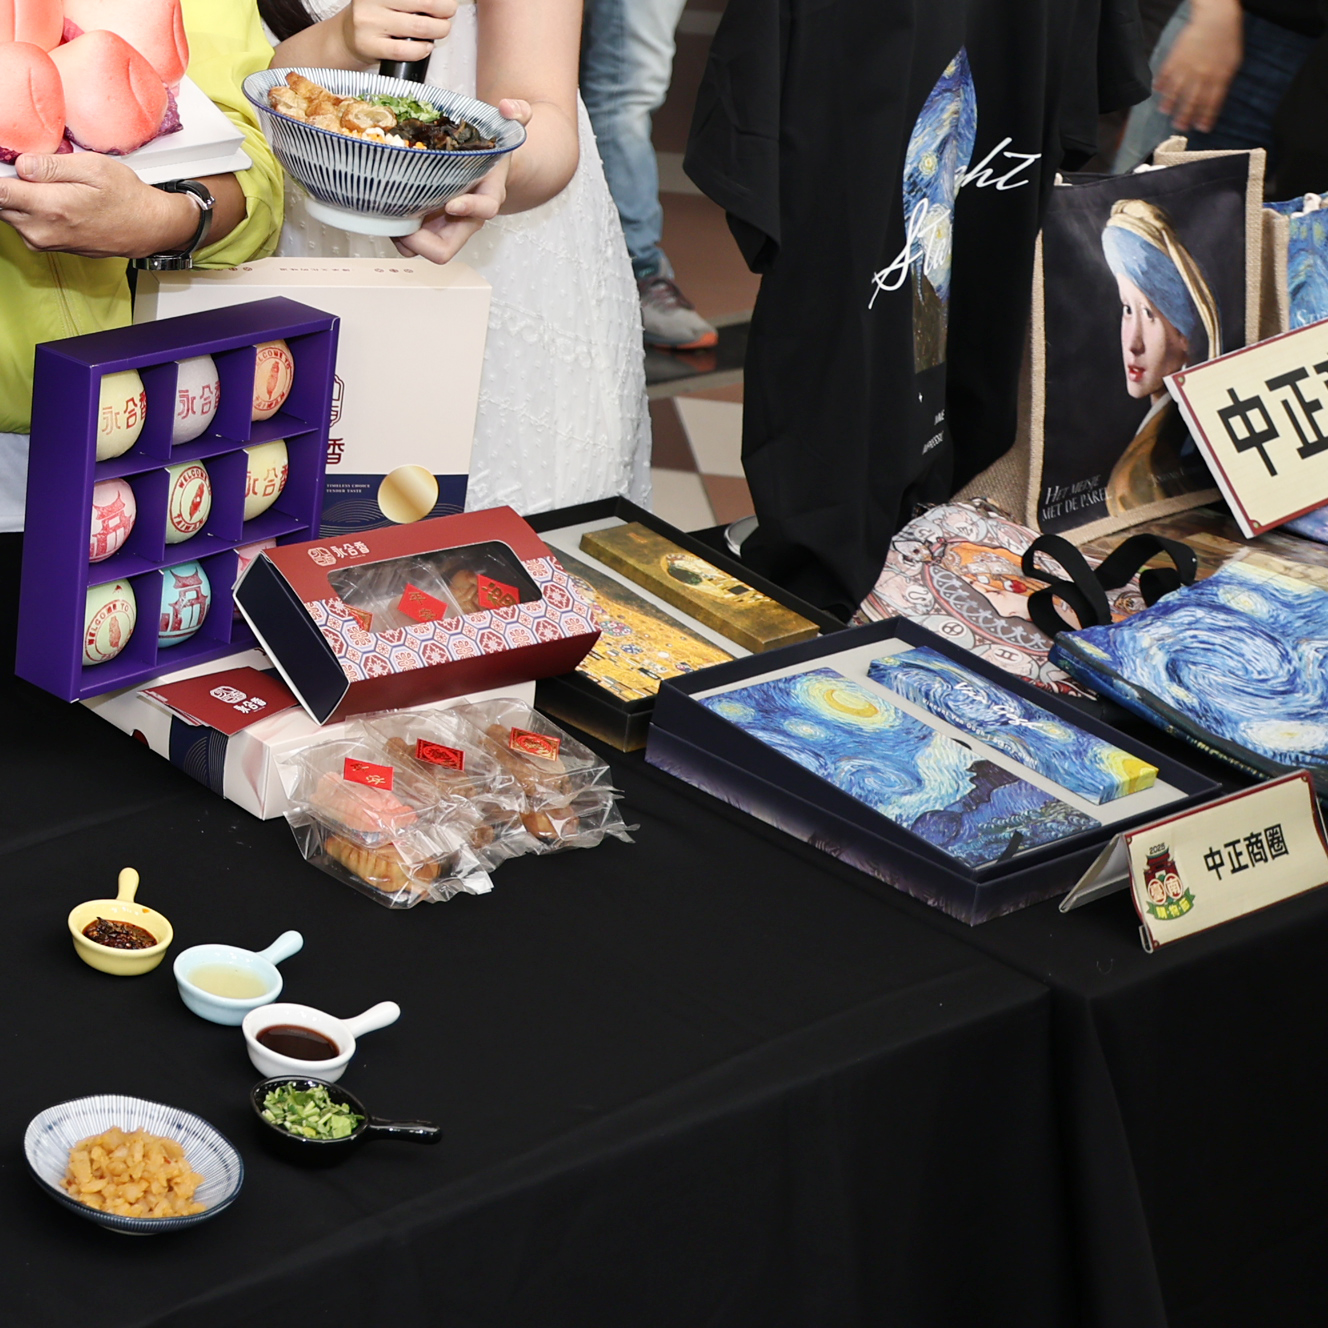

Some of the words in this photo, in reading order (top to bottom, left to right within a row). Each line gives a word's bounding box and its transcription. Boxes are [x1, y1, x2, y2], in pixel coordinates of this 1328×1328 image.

[1217, 357, 1328, 478] 中正
[1149, 842, 1166, 855] 2025
[1203, 823, 1289, 881] 中正商圈
